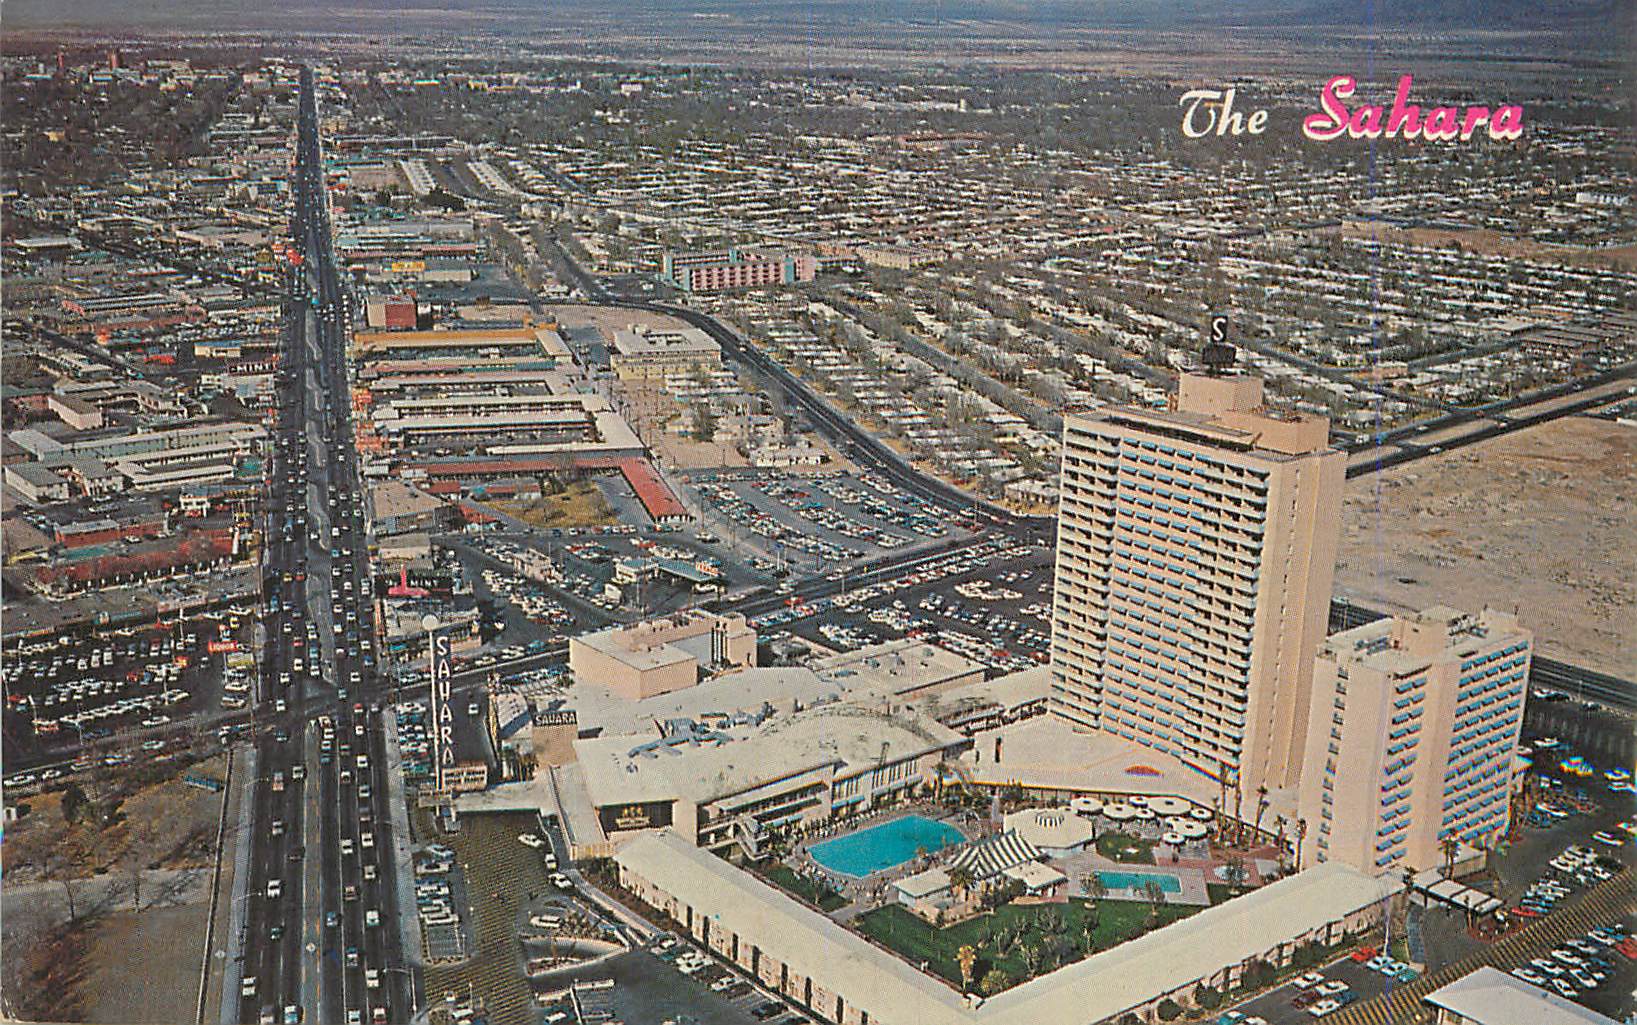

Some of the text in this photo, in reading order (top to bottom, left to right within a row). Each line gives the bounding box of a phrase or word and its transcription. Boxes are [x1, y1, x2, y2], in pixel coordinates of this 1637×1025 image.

[1212, 317, 1227, 341] S
[436, 636, 454, 765] SAHARA
[535, 712, 577, 726] SAHARA
